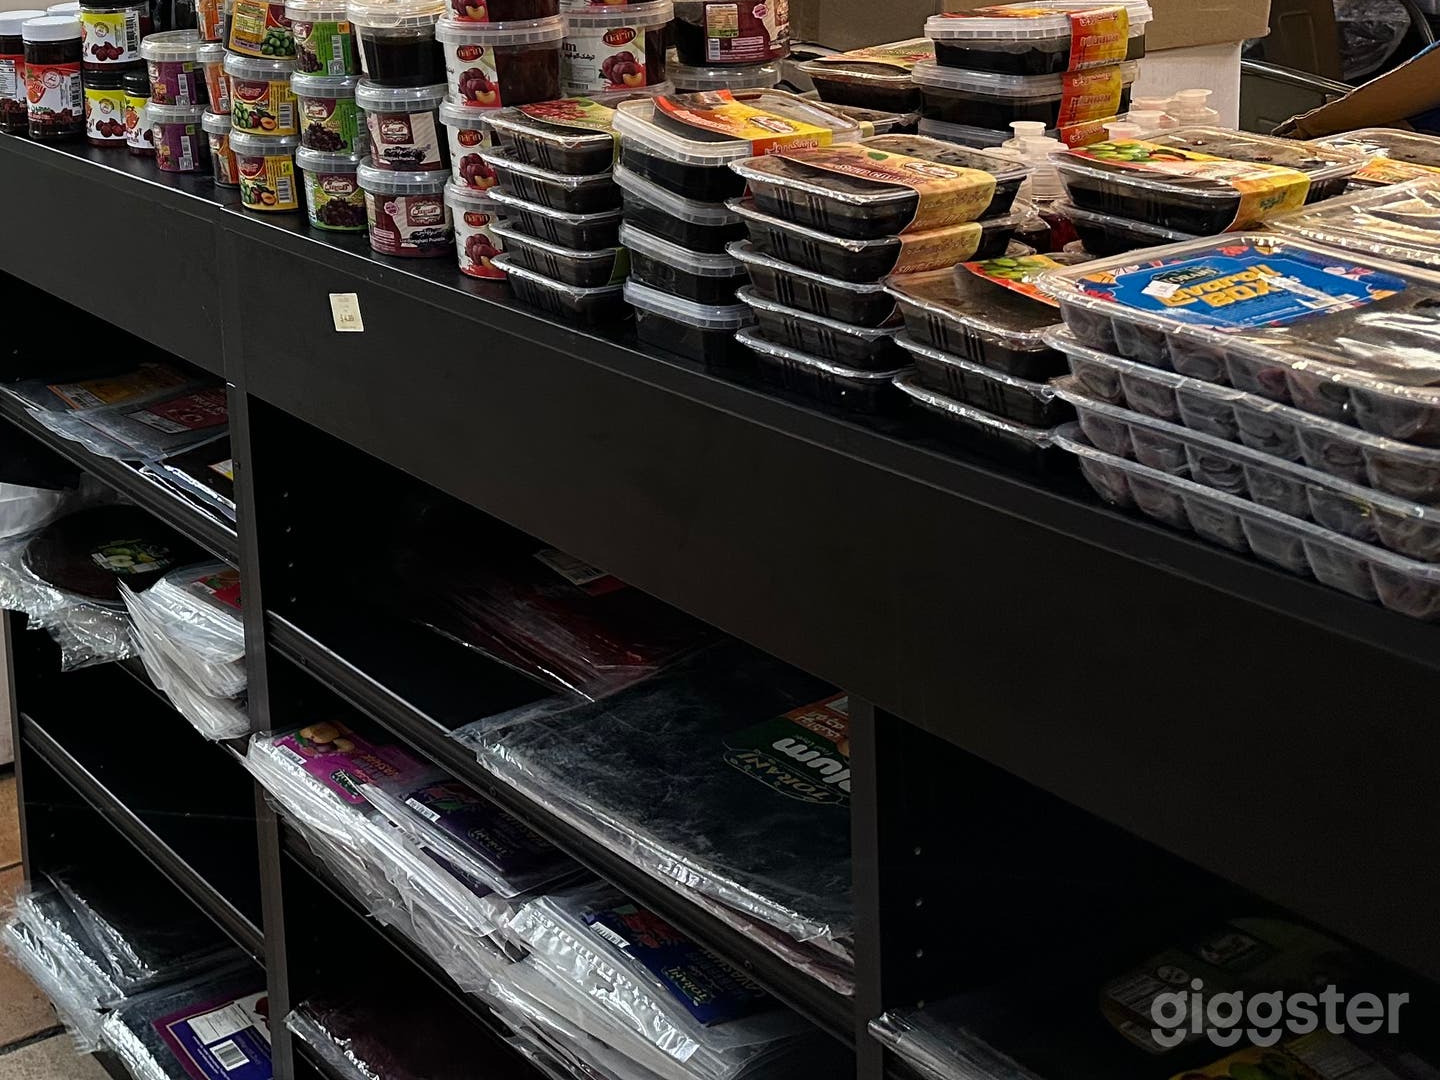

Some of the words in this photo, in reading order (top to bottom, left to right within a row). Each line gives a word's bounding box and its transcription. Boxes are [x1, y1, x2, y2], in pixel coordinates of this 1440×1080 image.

[605, 30, 635, 41] narin
[734, 752, 831, 801] TORANI
[667, 966, 709, 1003] TORANI
